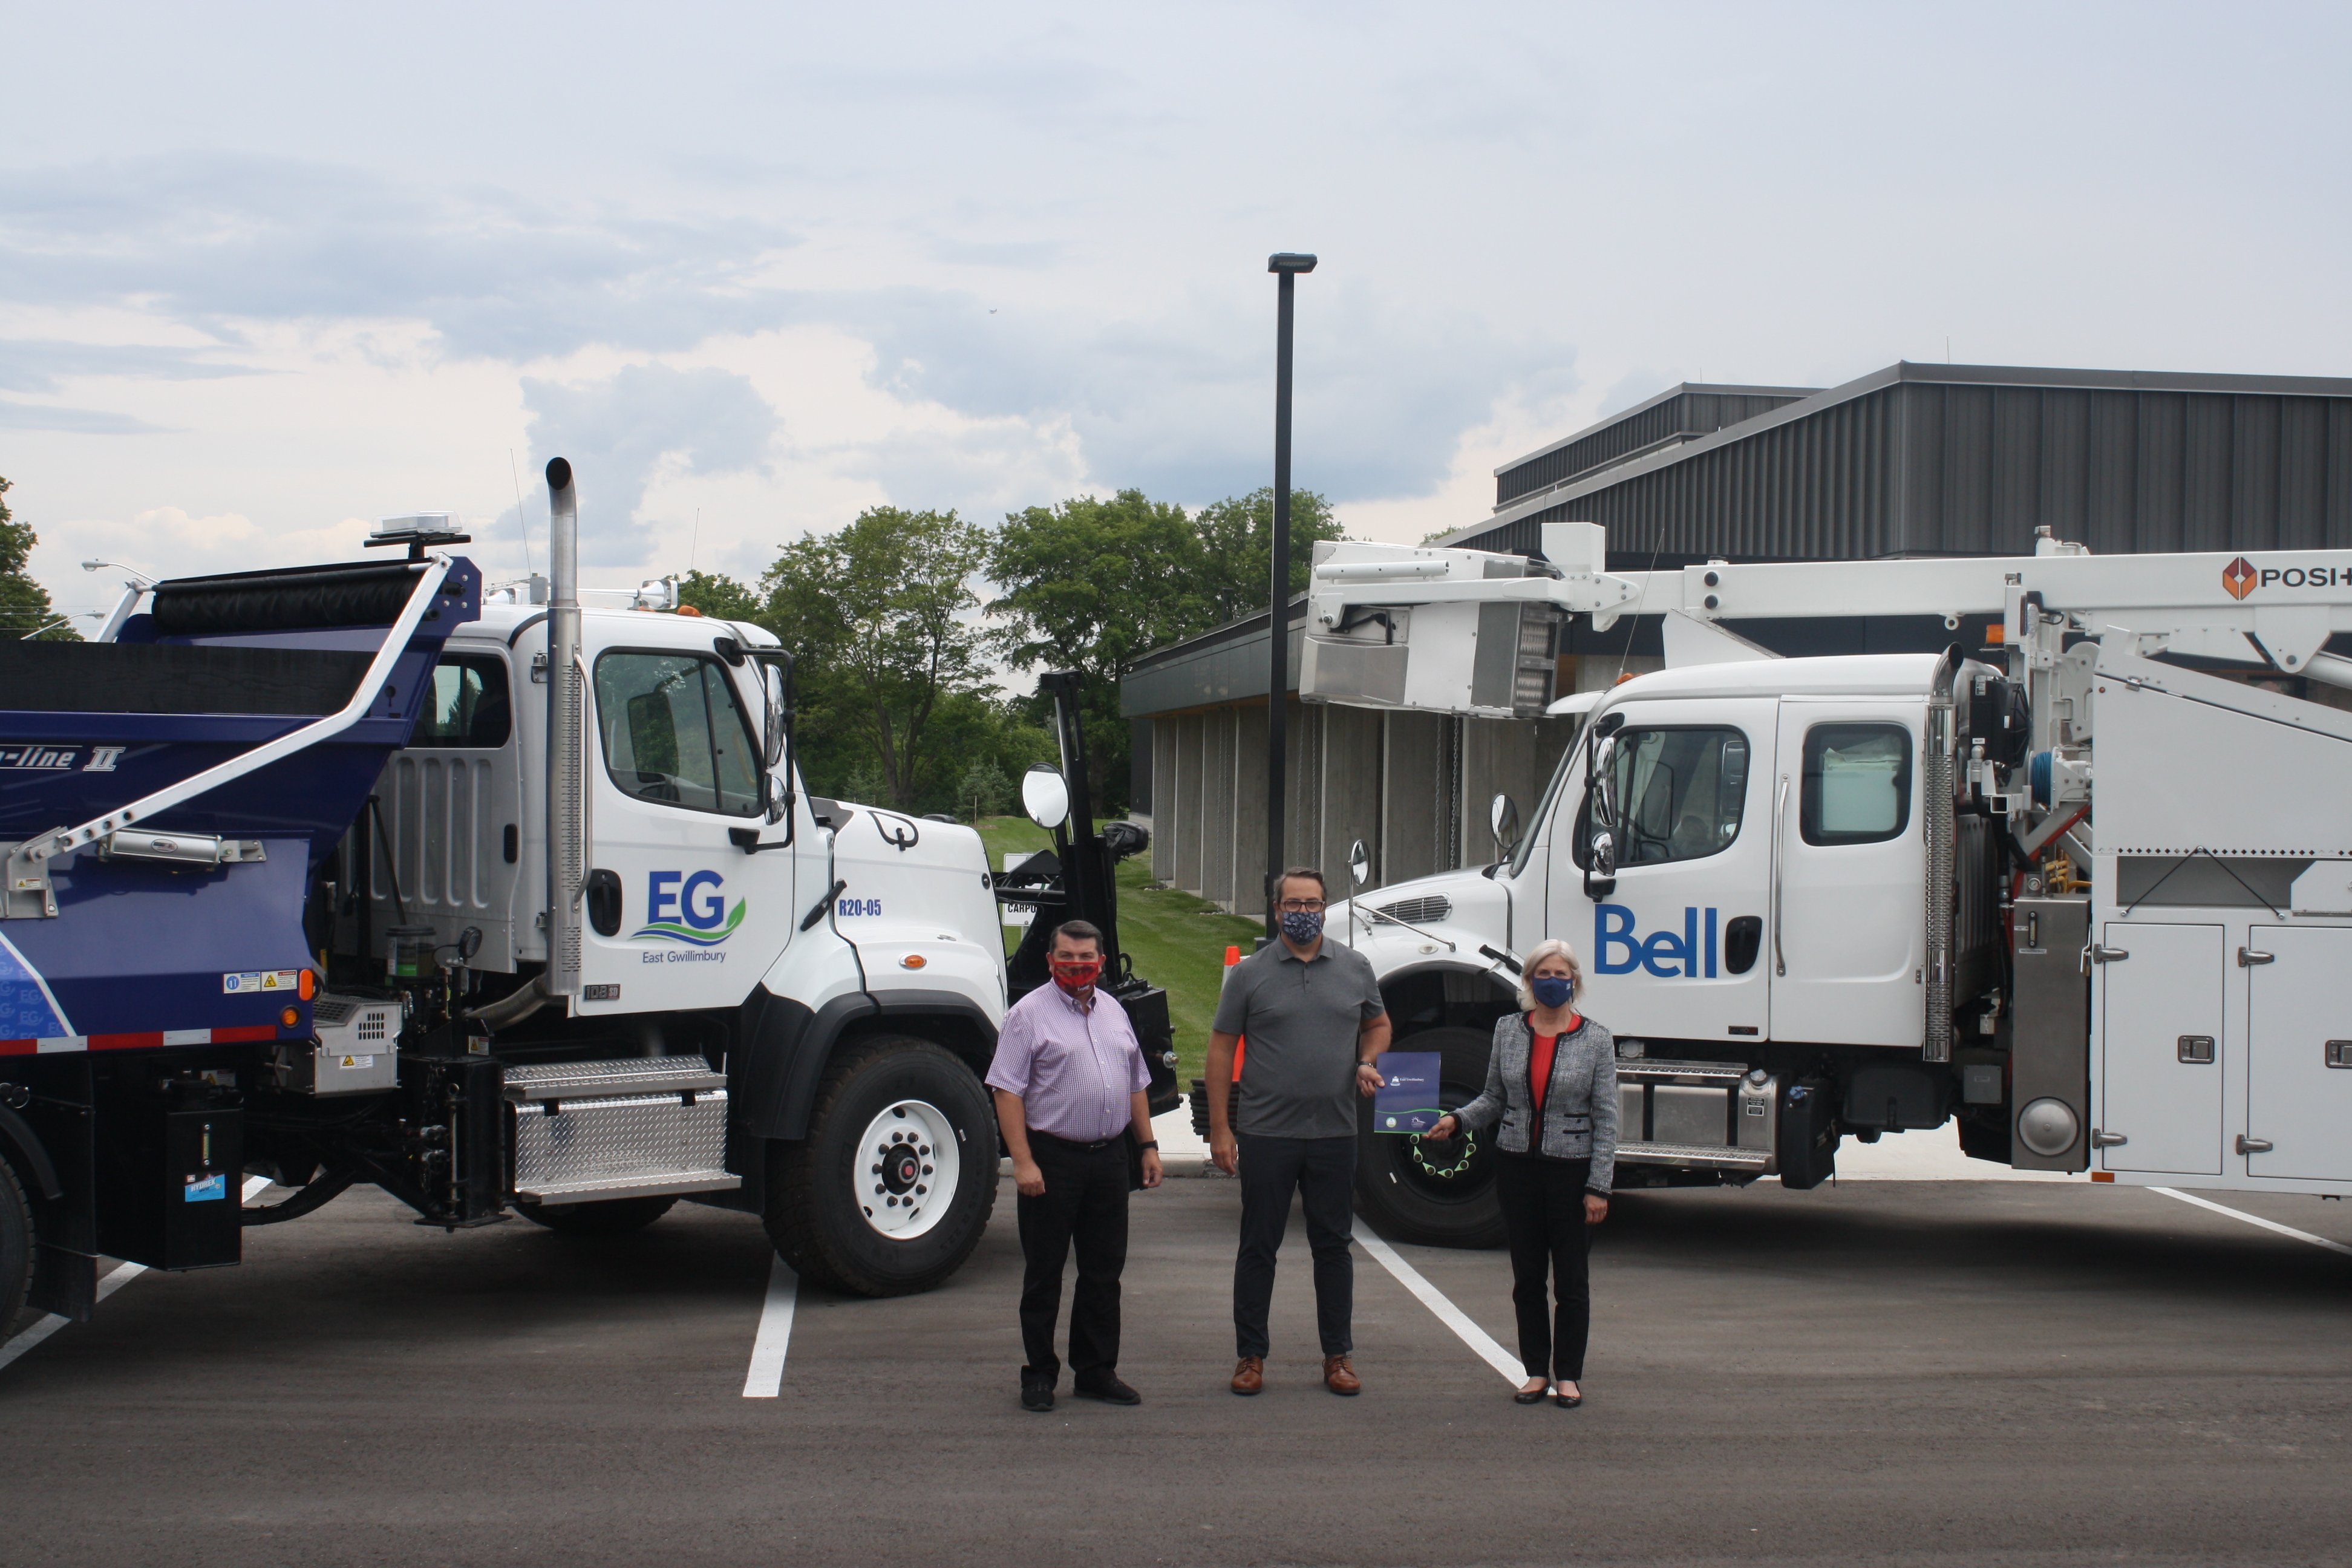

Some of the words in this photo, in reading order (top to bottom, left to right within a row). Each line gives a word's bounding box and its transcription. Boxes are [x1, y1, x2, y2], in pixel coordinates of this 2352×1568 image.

[648, 869, 724, 930] EG
[838, 898, 881, 916] R20-05
[642, 952, 664, 963] East
[667, 950, 727, 963] Gwillimbury
[1594, 904, 1717, 979] Bell
